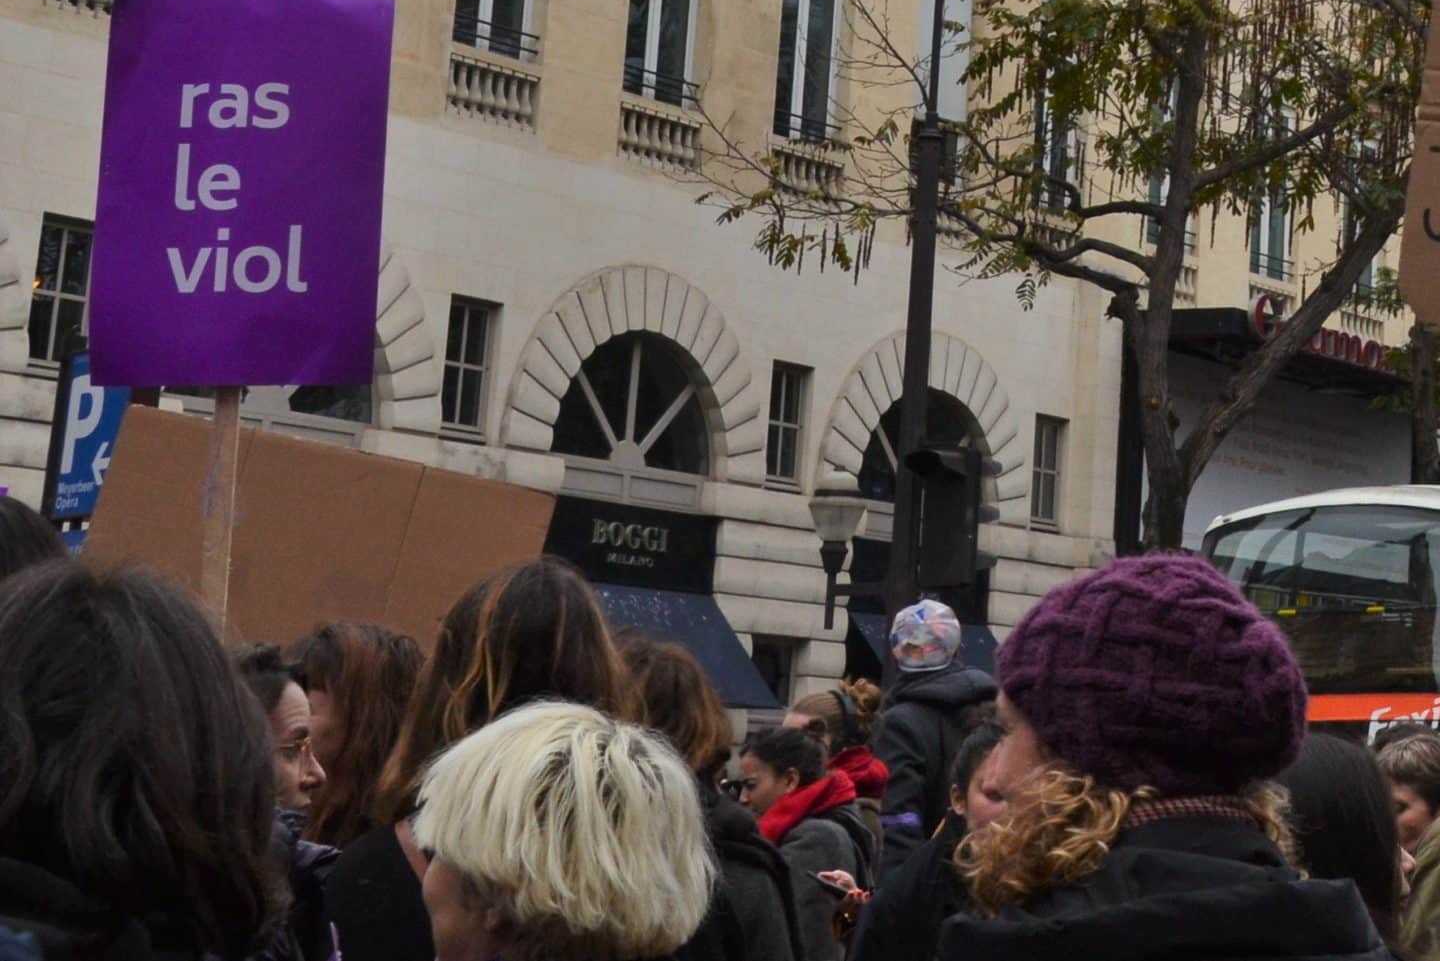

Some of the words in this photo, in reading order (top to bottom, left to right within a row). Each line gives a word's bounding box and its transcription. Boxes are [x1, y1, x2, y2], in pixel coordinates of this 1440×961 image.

[179, 82, 291, 129] ras
[173, 143, 242, 211] le
[166, 224, 309, 293] viol
[59, 373, 104, 475] P
[591, 518, 669, 553] BOGGI
[606, 551, 655, 568] MILANO
